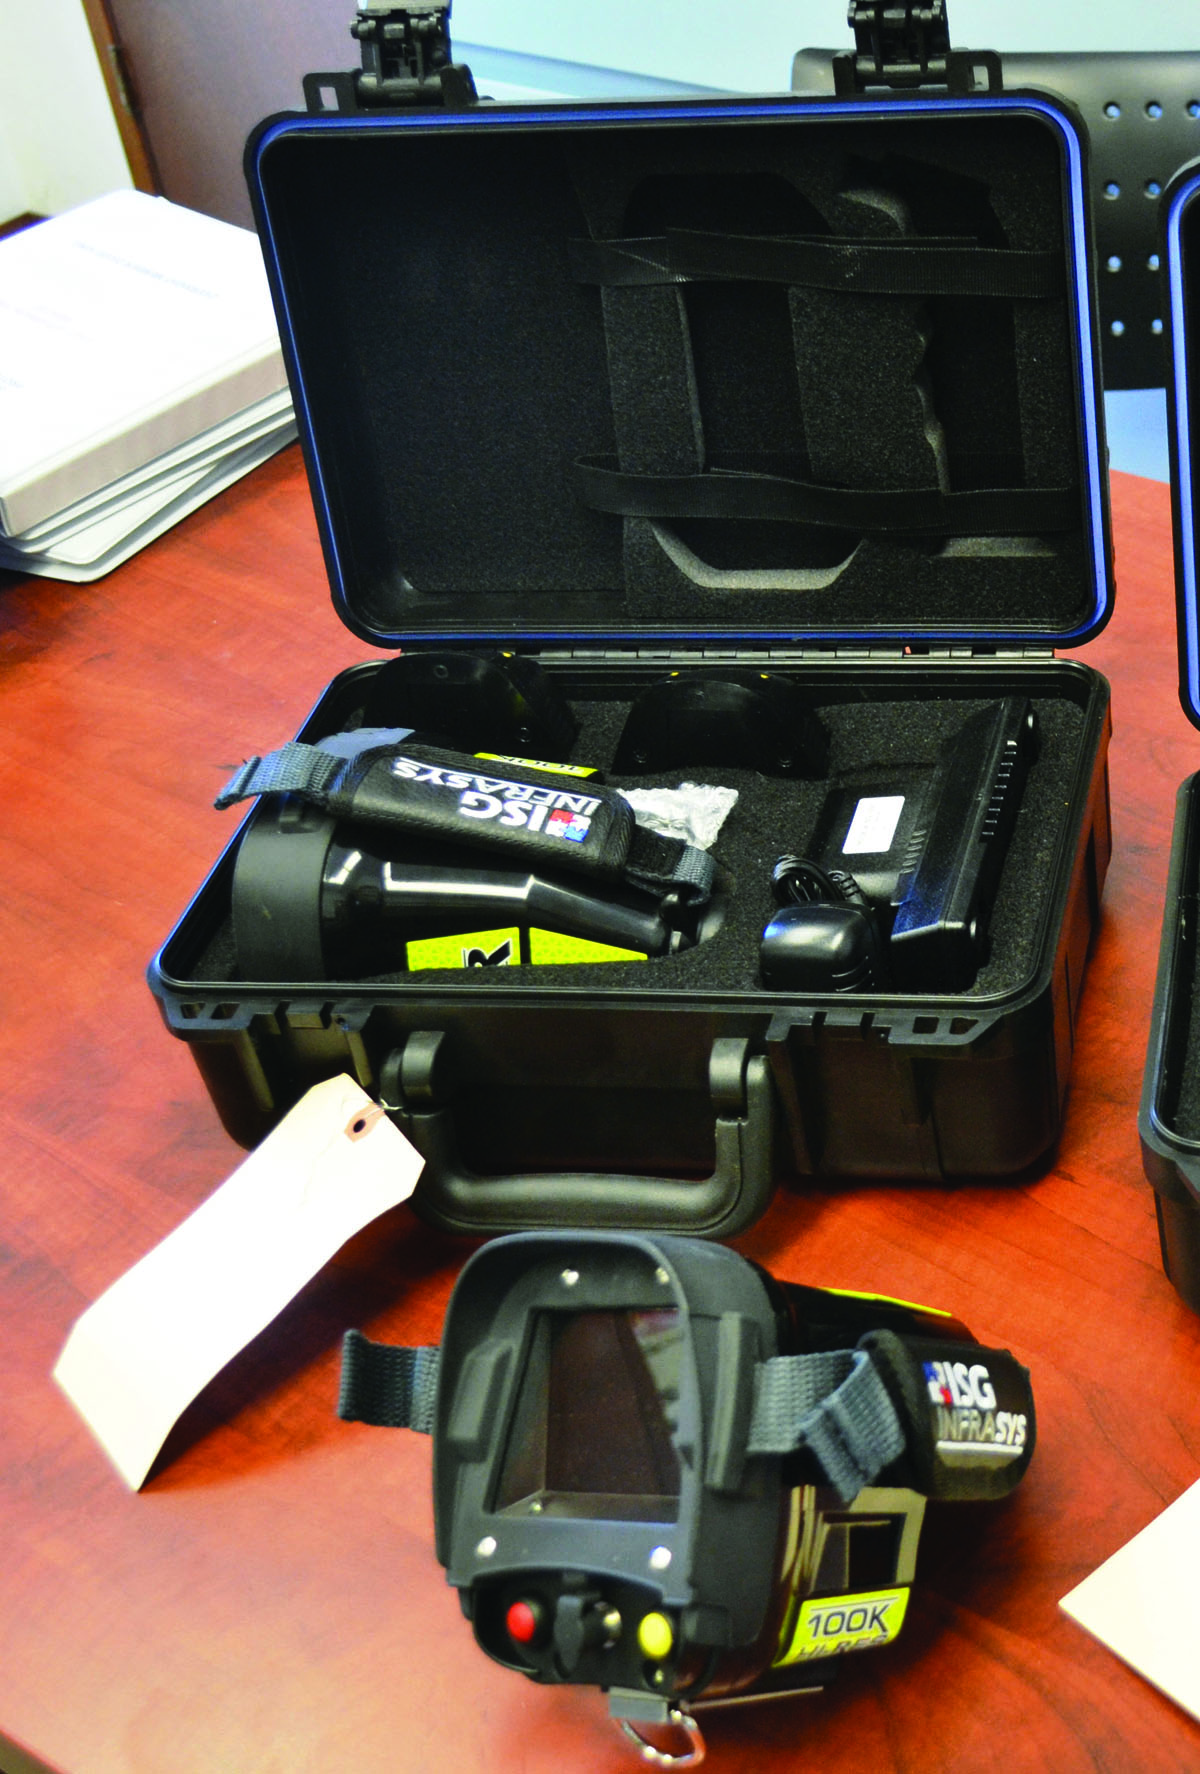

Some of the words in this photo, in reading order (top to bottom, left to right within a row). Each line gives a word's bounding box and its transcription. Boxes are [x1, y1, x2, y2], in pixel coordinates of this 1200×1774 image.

[391, 760, 601, 816] INFRASYS
[459, 790, 549, 832] ISG
[942, 1361, 997, 1410] ISG
[937, 1408, 1027, 1446] INFRASYS
[808, 1603, 890, 1638] 100K
